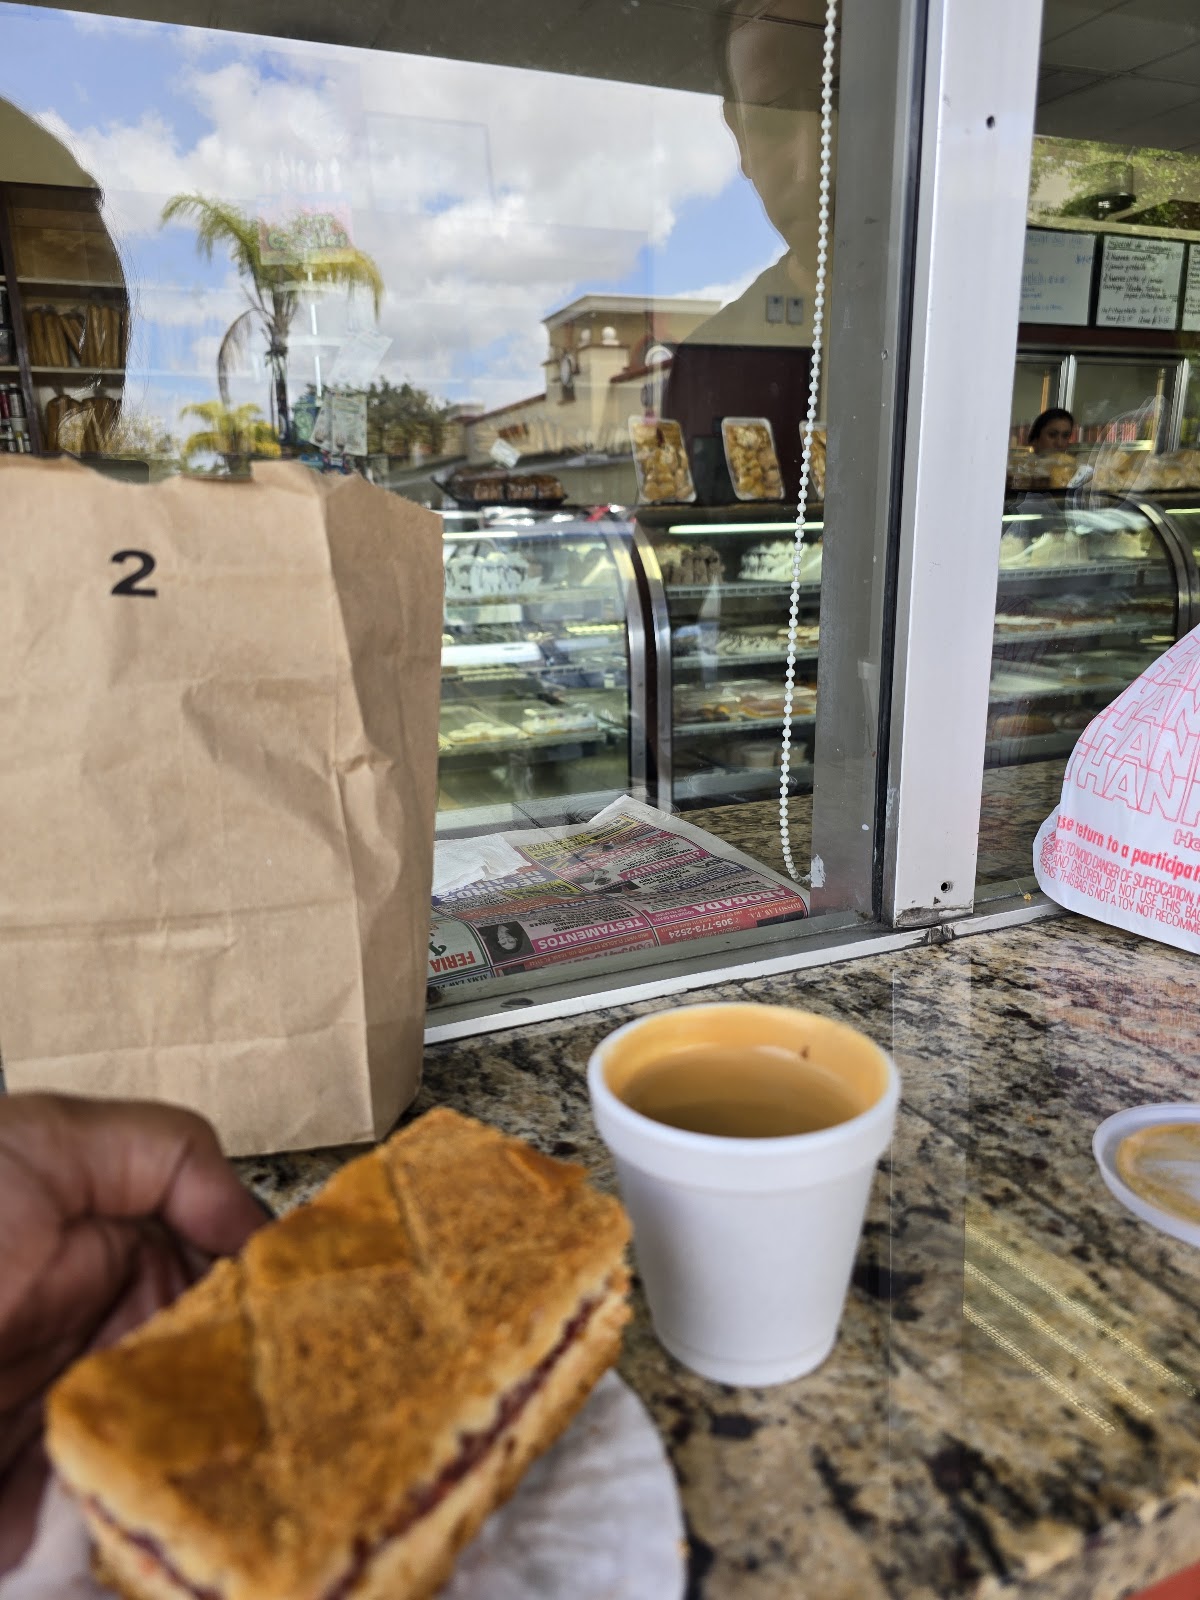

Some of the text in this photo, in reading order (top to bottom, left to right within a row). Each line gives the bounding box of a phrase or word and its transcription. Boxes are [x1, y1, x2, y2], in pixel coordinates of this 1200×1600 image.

[110, 550, 156, 597] 2
[1075, 822, 1104, 847] return
[1106, 835, 1119, 853] to
[1121, 844, 1130, 858] a
[1092, 855, 1120, 880] DANGER
[1121, 868, 1133, 883] OF
[692, 889, 786, 913] ABOGADA
[1087, 884, 1095, 897] IS
[1095, 887, 1110, 903] NOT
[1110, 893, 1116, 905] A
[1136, 903, 1154, 918] NOT
[1105, 877, 1116, 893] DO
[1118, 883, 1137, 899] NOT
[1140, 890, 1158, 907] USE
[1162, 897, 1180, 914] THIS
[538, 917, 643, 949] TESTAMENTOS
[668, 917, 733, 939] 305-773-2524
[430, 950, 476, 973] FERIA
